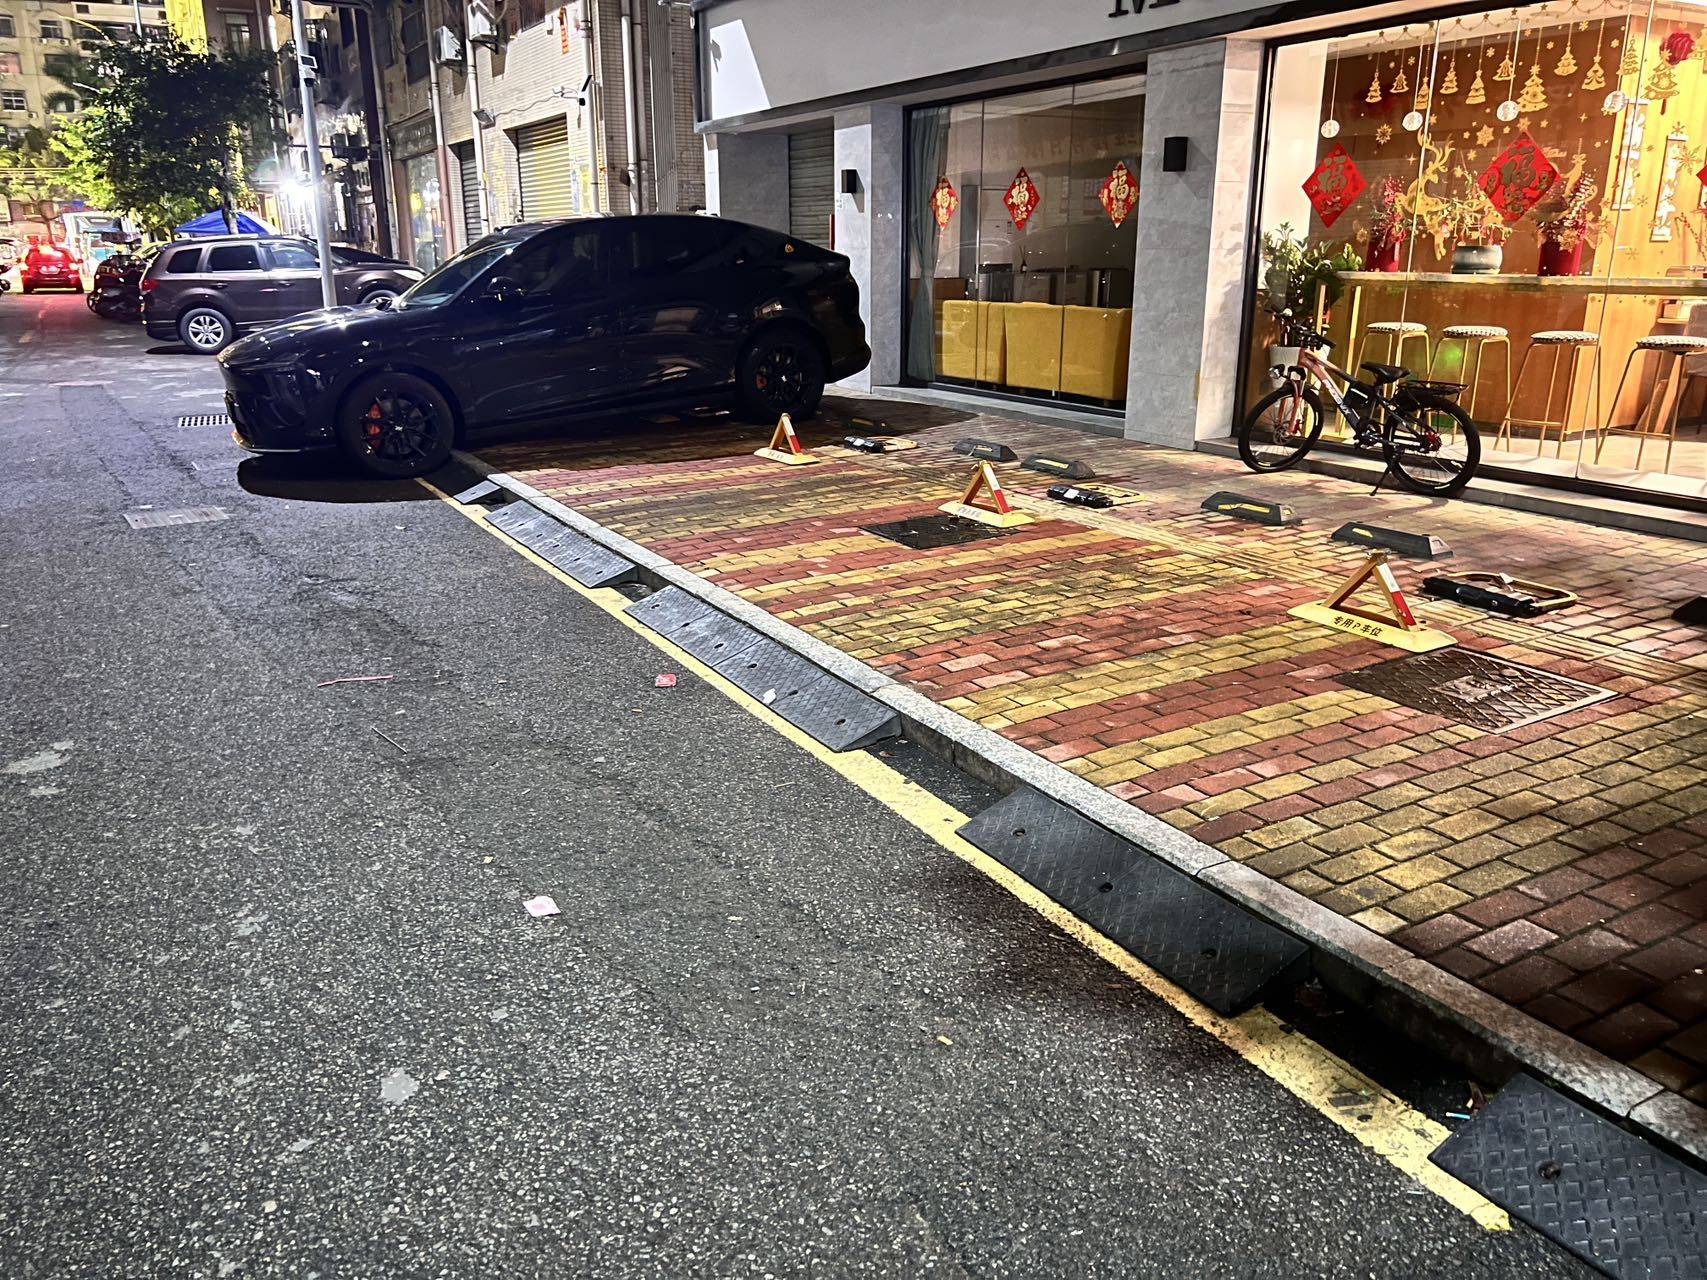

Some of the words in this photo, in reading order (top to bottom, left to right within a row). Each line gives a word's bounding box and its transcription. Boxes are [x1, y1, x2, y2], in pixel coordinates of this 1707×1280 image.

[1109, 169, 1130, 201] 福
[1317, 155, 1347, 194] 福
[1501, 146, 1536, 190] 福
[1008, 176, 1030, 206] 福
